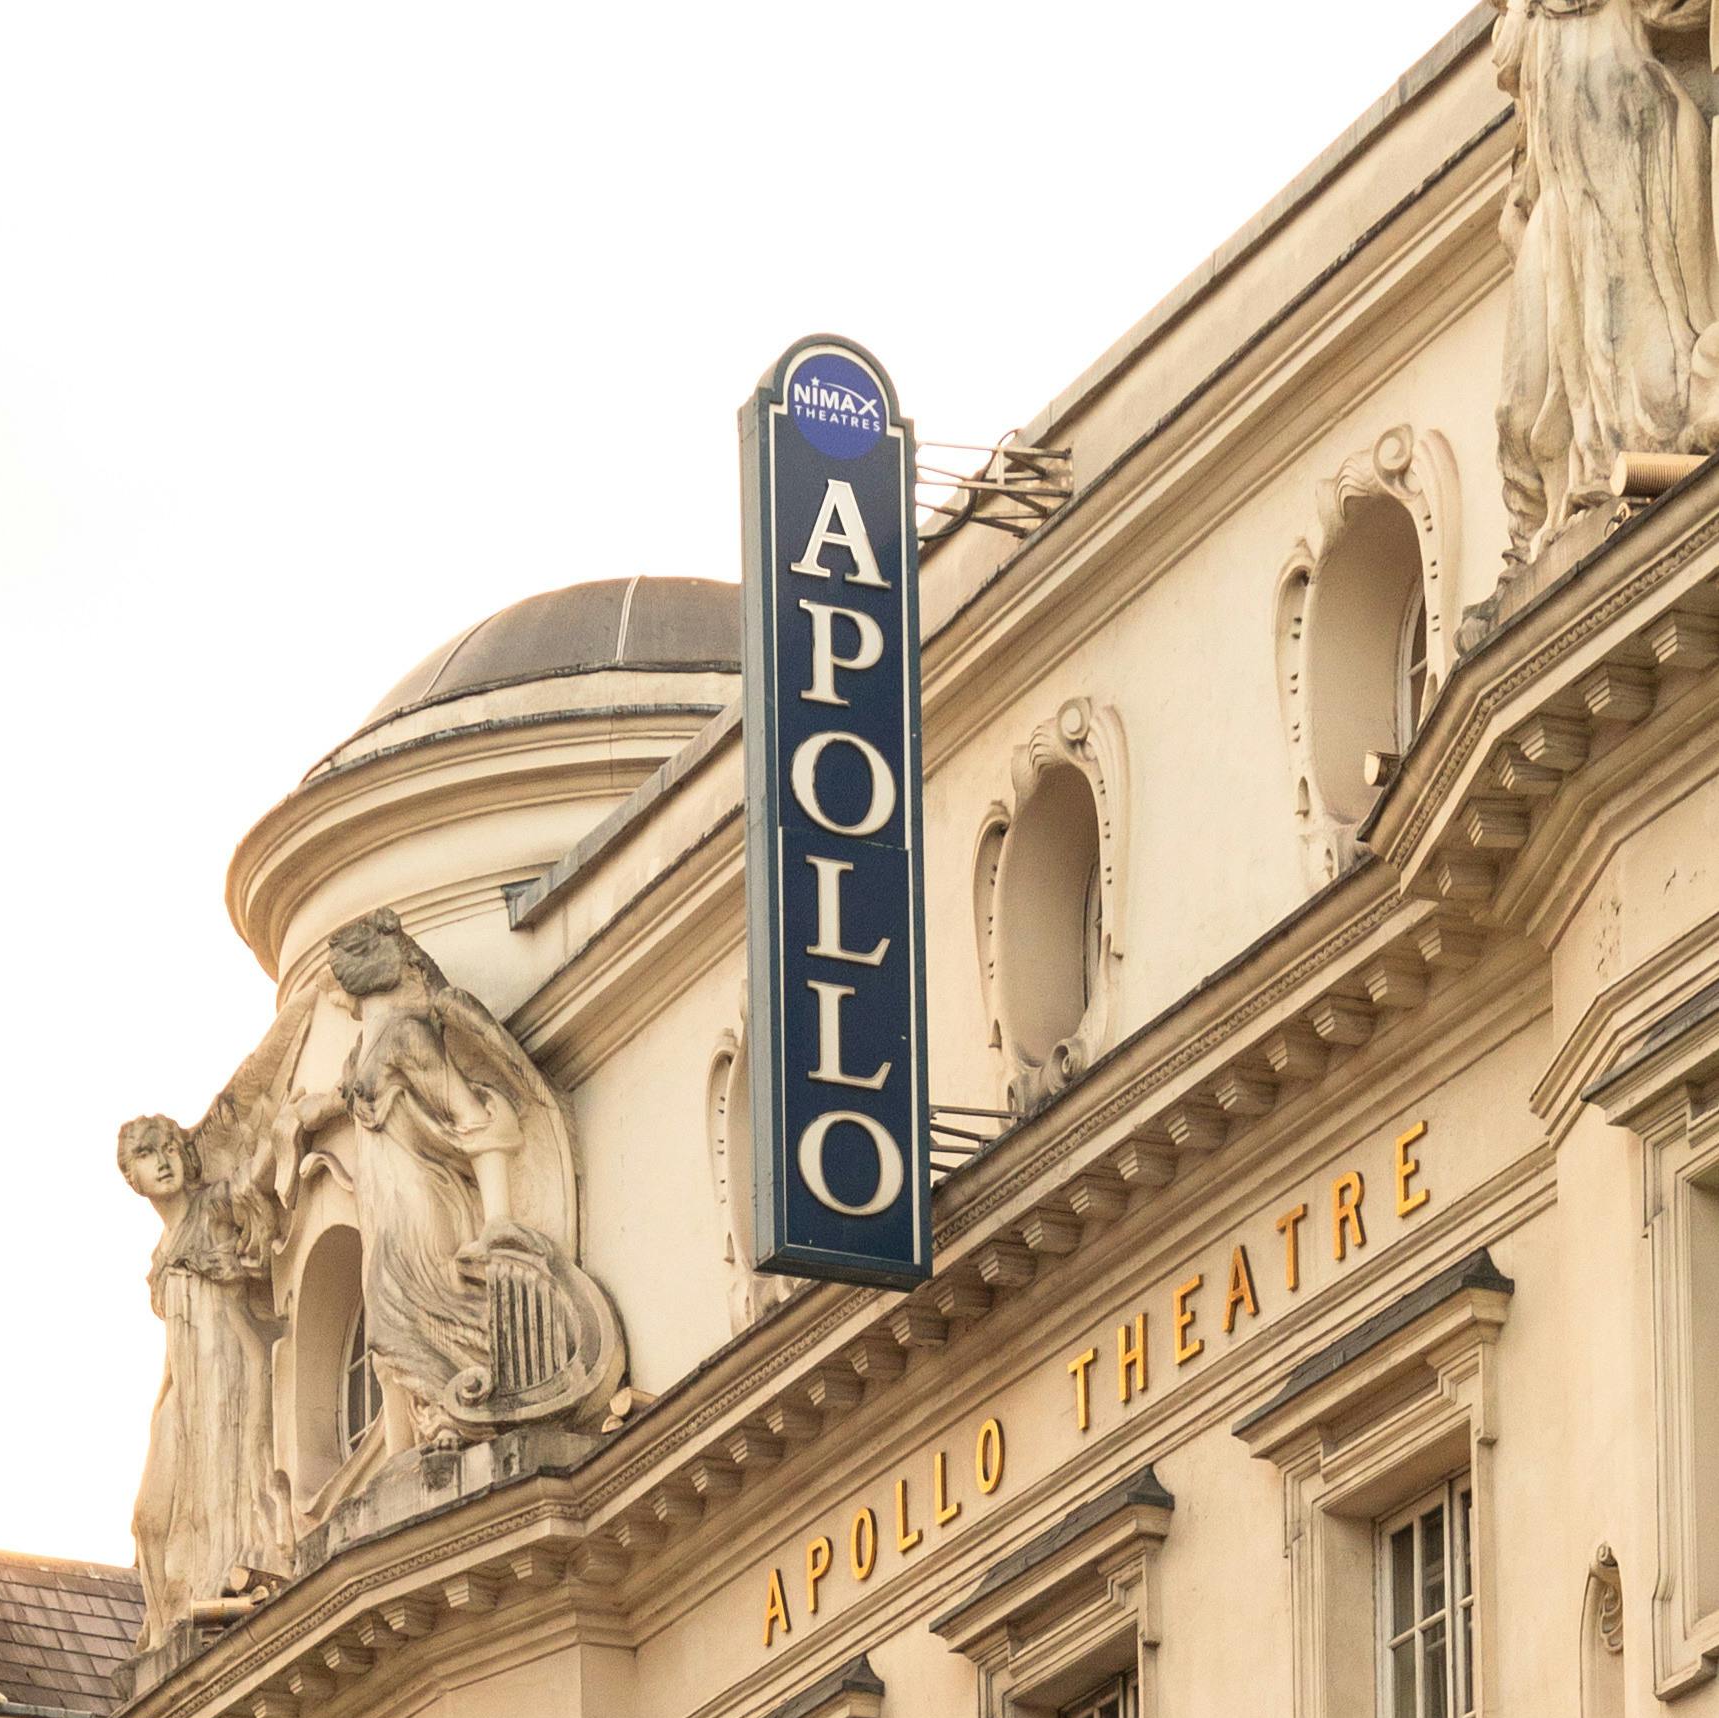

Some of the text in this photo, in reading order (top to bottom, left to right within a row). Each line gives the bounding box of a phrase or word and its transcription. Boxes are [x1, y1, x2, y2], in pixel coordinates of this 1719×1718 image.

[794, 405, 881, 432] THEATRES
[789, 478, 905, 1217] APOLLO
[763, 1119, 1430, 1646] APOLLO THEATRE
